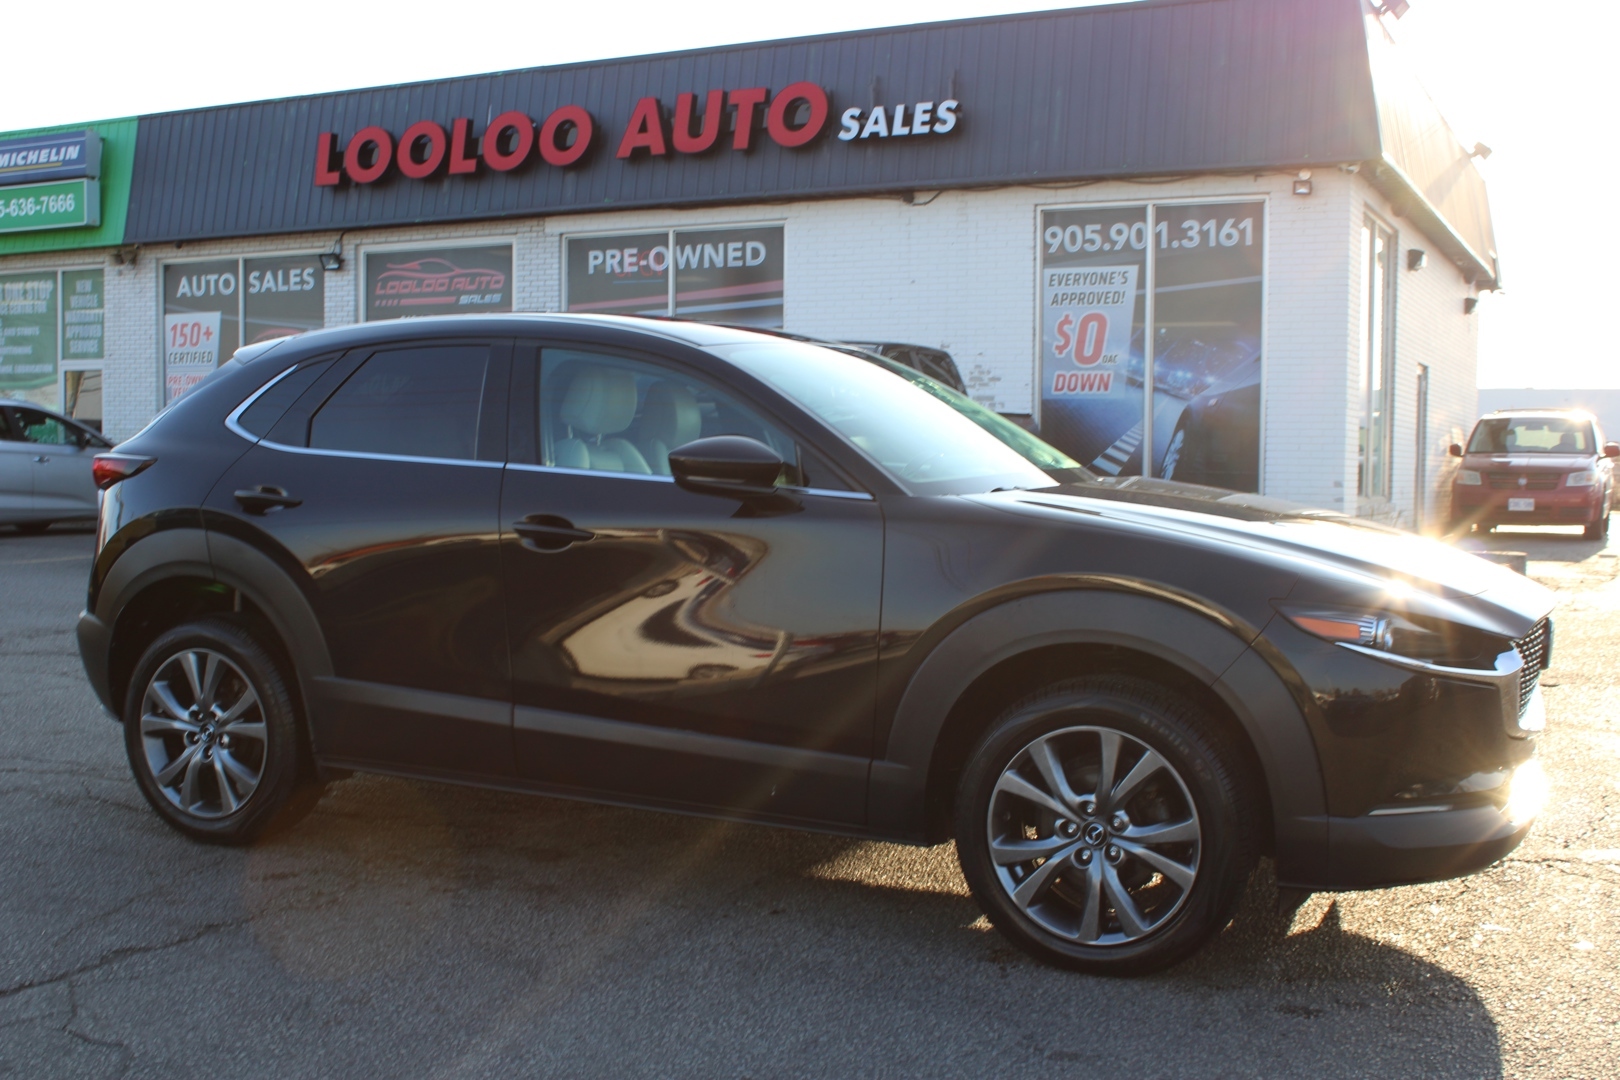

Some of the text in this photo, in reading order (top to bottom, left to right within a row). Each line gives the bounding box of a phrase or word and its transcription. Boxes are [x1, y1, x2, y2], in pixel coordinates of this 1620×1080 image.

[314, 81, 960, 186] LOOLOO AUTO SALES
[0, 144, 80, 168] MICHELIN
[1044, 217, 1255, 254] 905.901.3161
[588, 240, 767, 275] PRE-OWNED
[25, 279, 54, 300] STOP
[176, 266, 316, 298] AUTO SALES
[374, 275, 505, 295] LOOLOO AUTO
[1048, 270, 1130, 288] EVERYONE'S
[459, 293, 503, 305] SALES
[1050, 290, 1127, 307] APPROVED!
[170, 322, 214, 348] 150+
[1053, 312, 1109, 367] $0
[168, 350, 214, 365] CERTIFIED
[1053, 372, 1112, 393] DOWN
